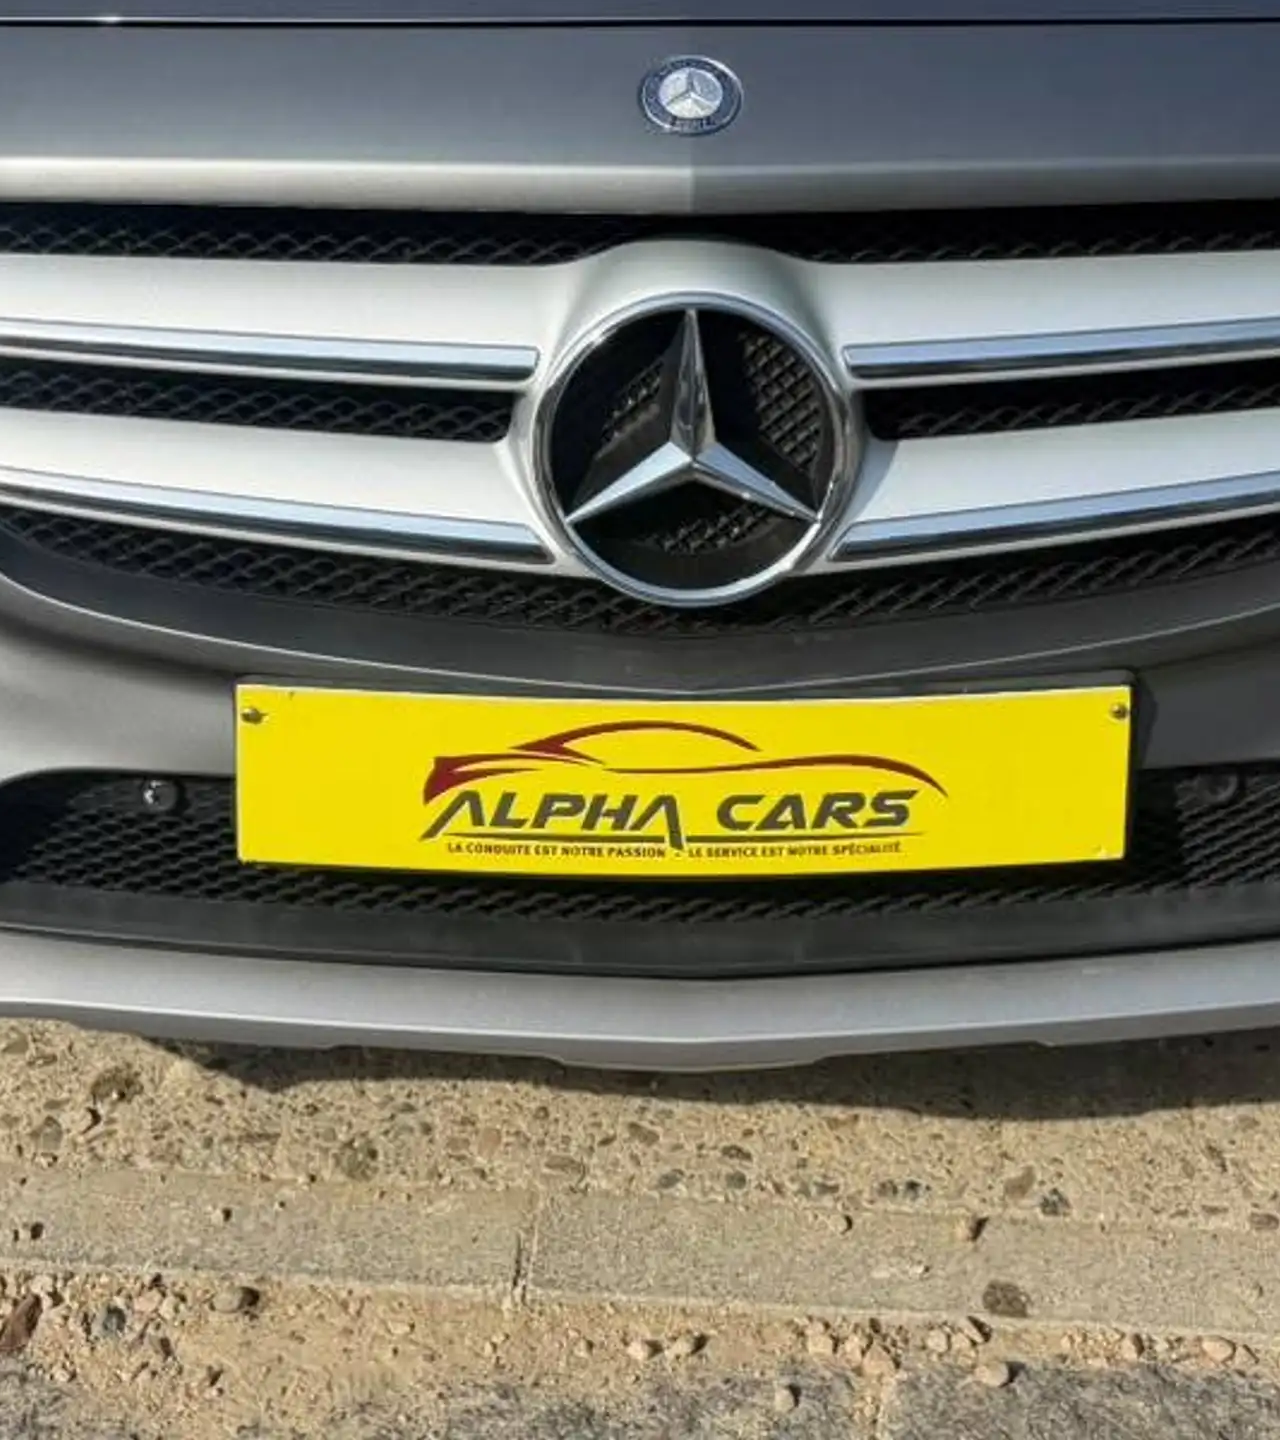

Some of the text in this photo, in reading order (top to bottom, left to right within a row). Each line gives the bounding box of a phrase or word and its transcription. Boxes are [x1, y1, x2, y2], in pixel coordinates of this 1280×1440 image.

[419, 790, 919, 850] ALPHA CARS
[448, 842, 462, 853] LA
[466, 843, 532, 856] CONDUITE
[535, 845, 557, 857] EST
[608, 847, 666, 859] PASSION
[689, 847, 704, 858] LE
[707, 846, 758, 858] SERVICE
[762, 845, 783, 857] EST
[832, 841, 901, 855] SPÉCIALITÉ
